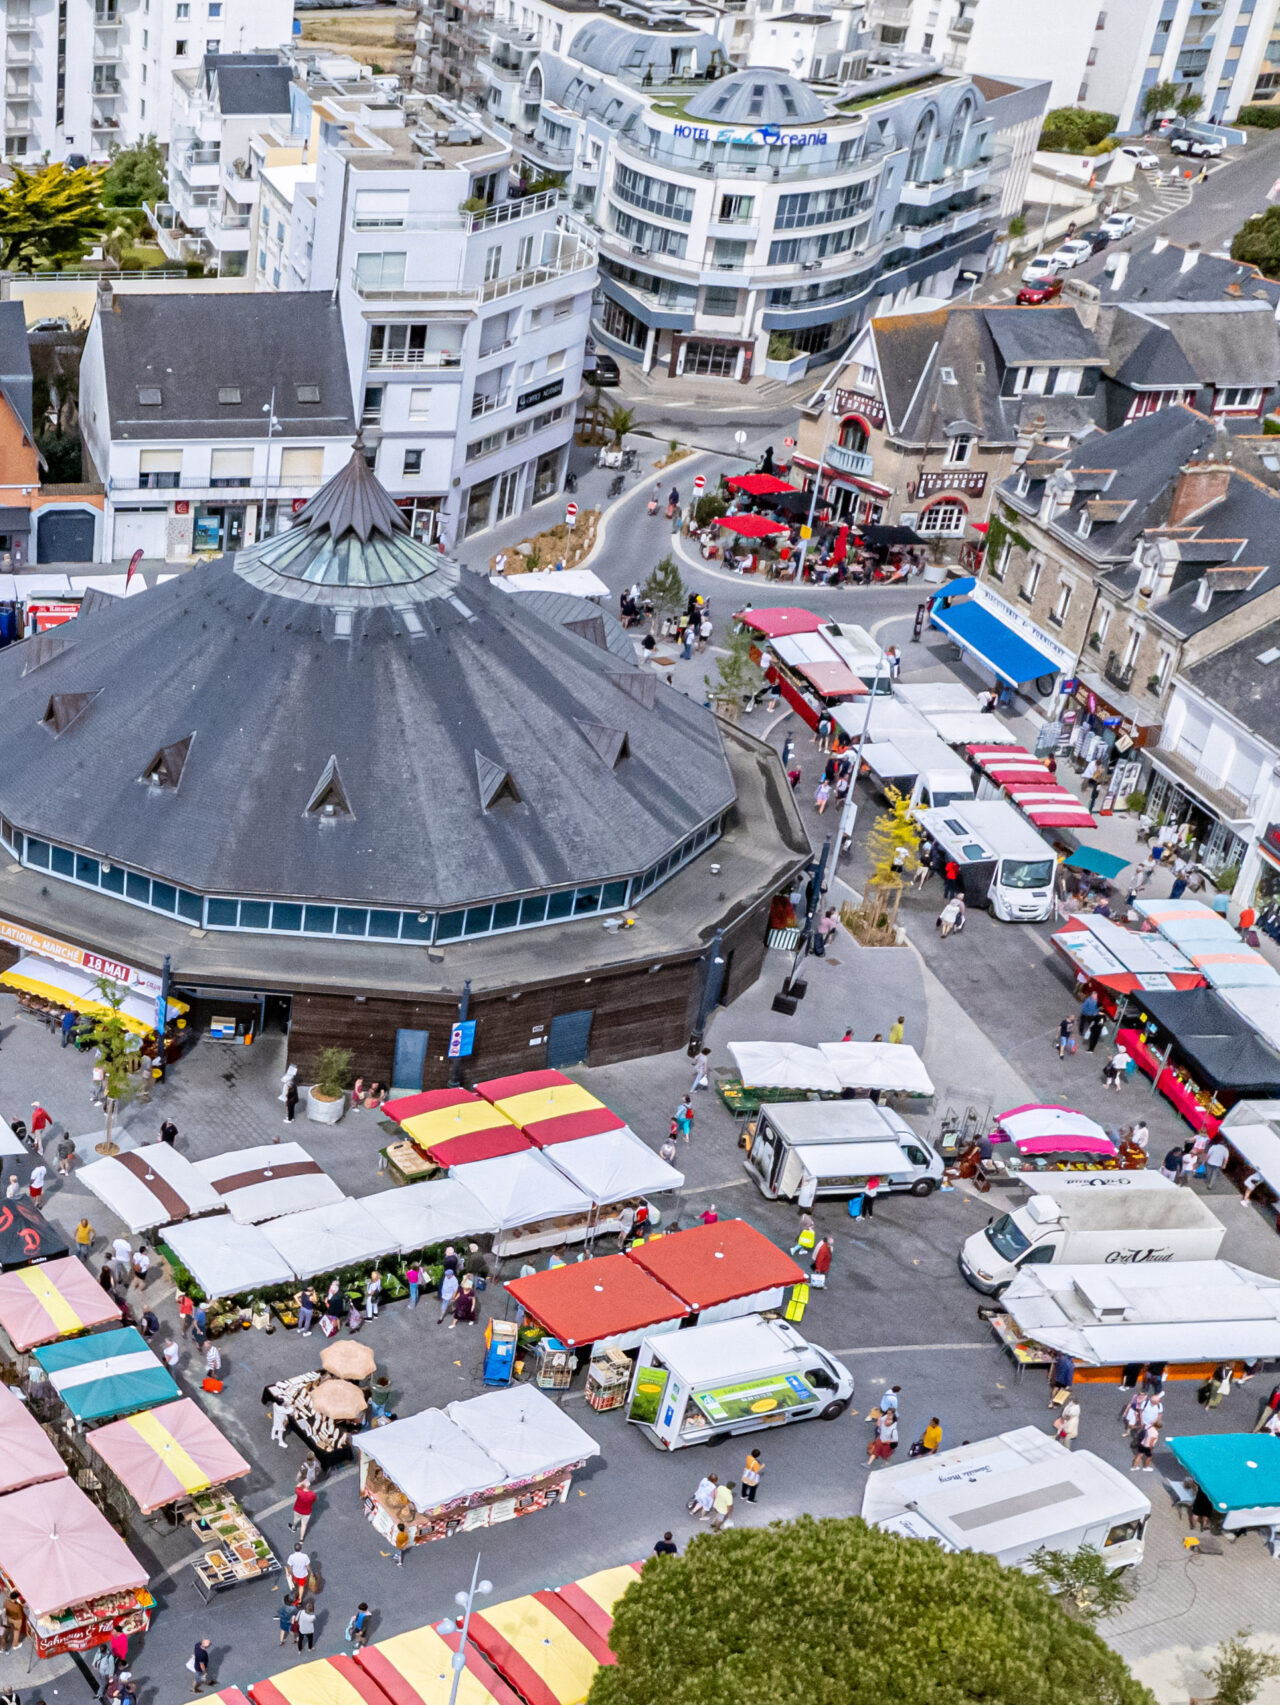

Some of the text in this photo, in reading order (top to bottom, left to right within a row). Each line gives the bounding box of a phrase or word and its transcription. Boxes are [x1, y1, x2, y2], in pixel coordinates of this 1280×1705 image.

[673, 123, 711, 142] HOTEL
[42, 940, 80, 960] MARCHÉ
[87, 956, 127, 980] 18 MAI
